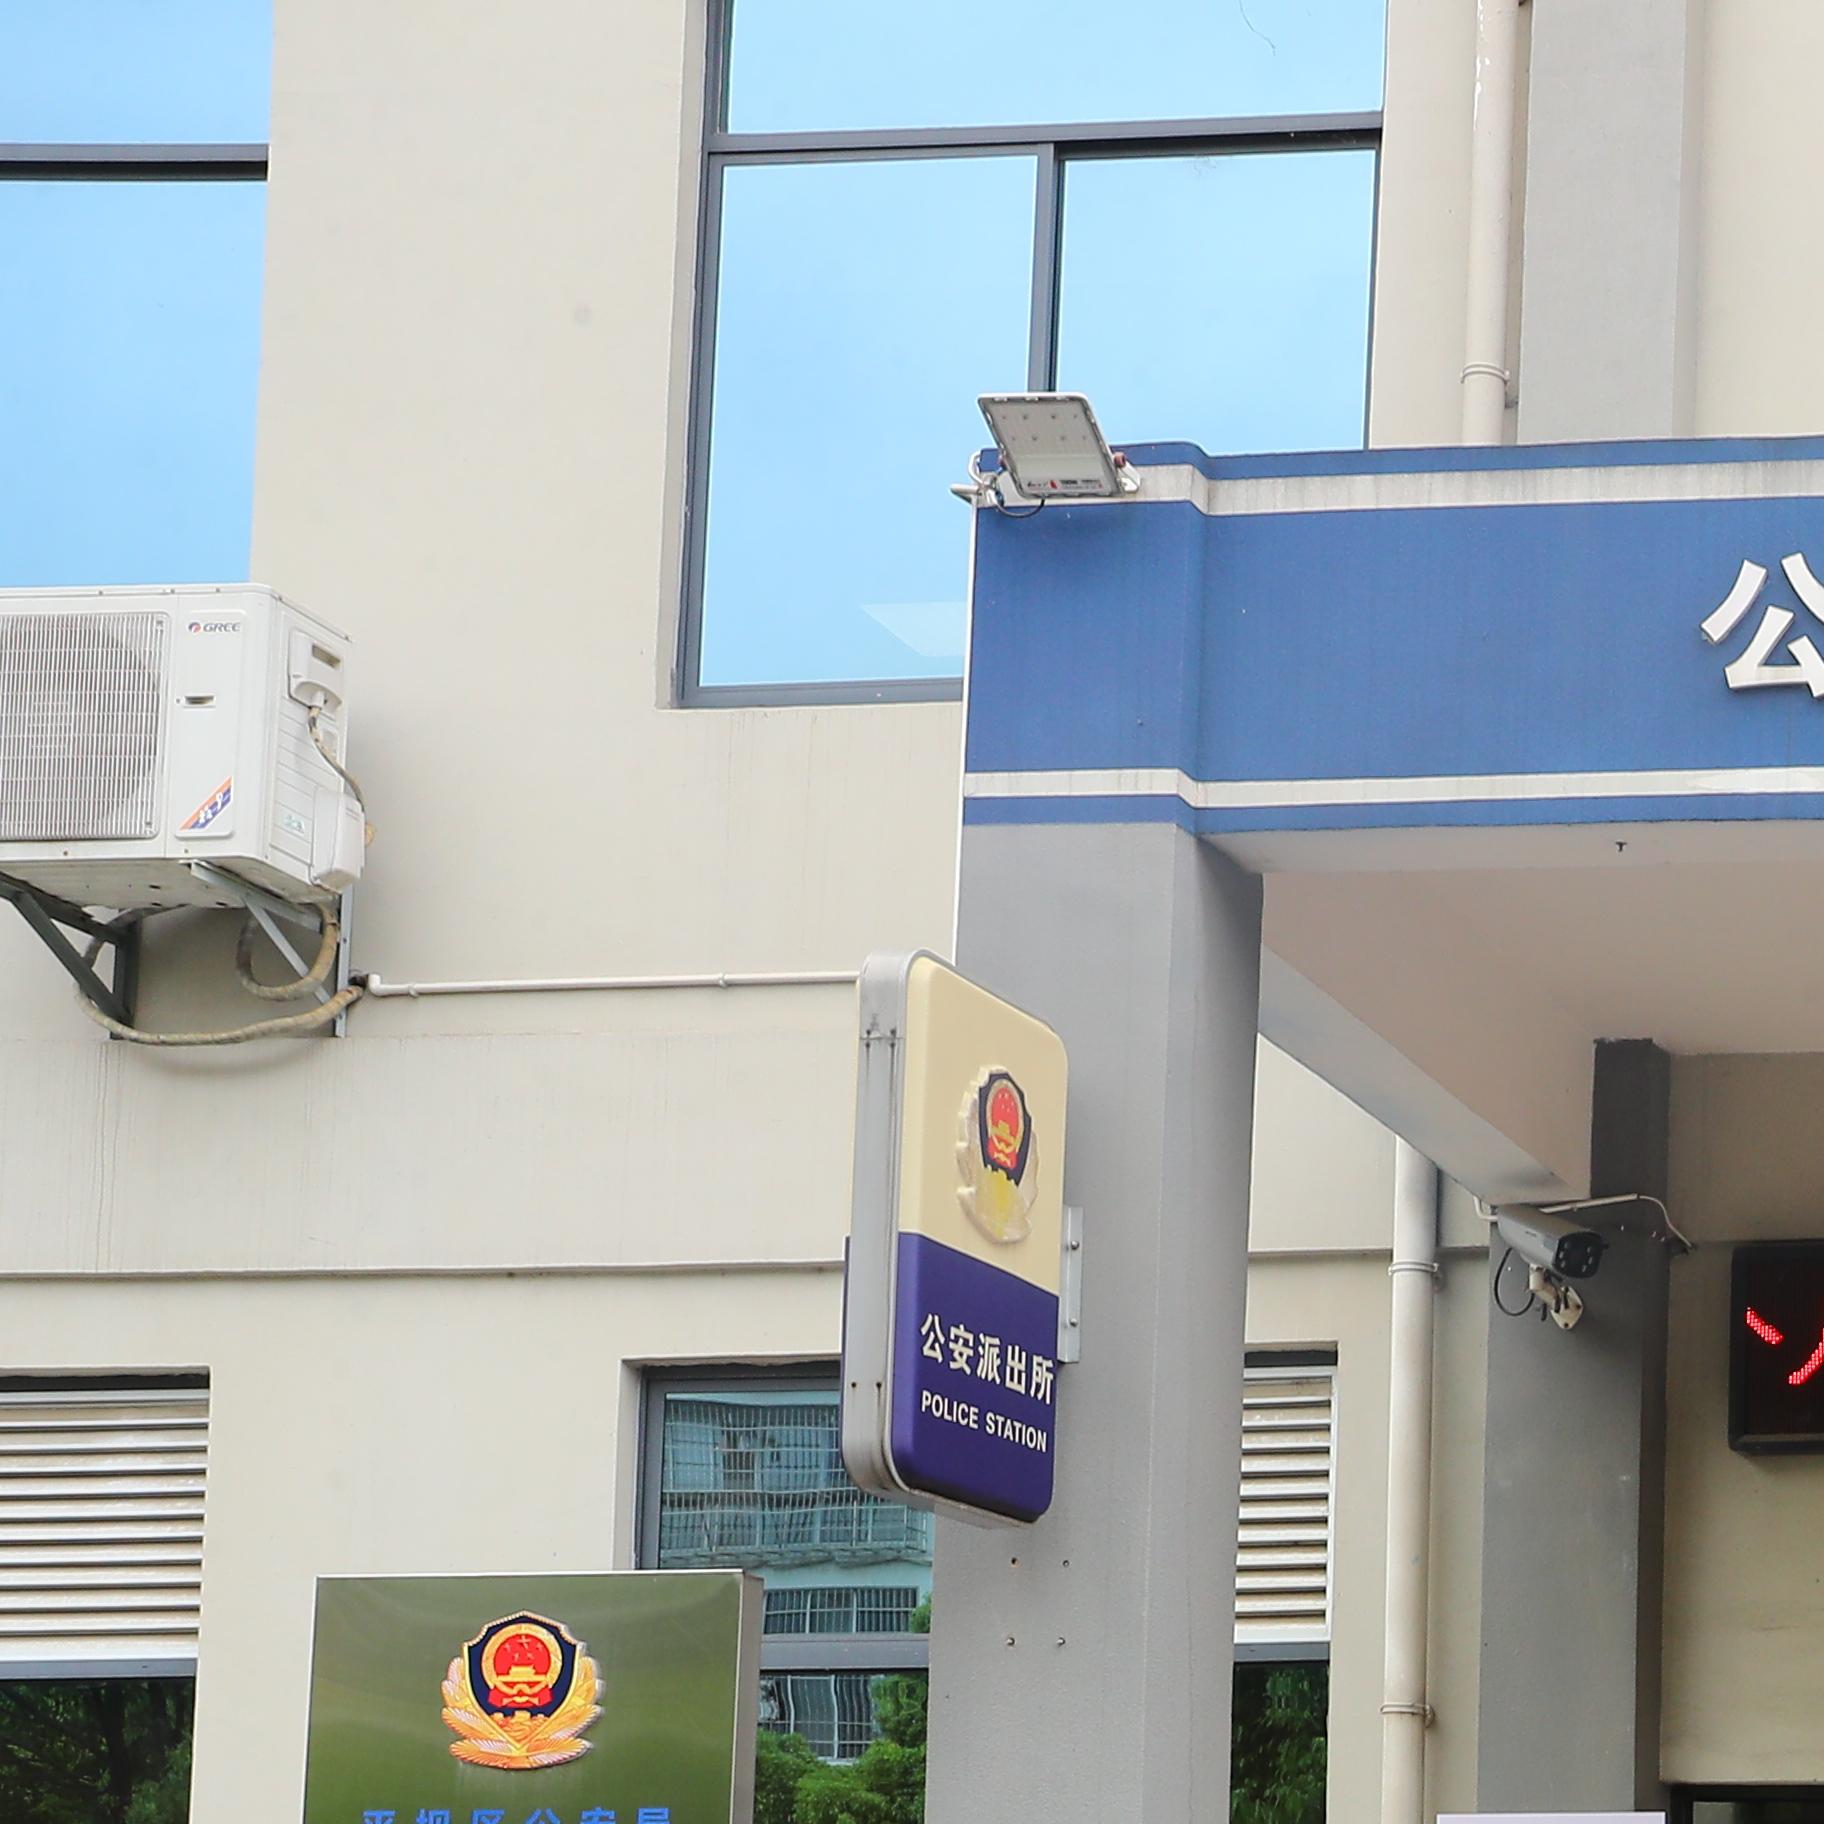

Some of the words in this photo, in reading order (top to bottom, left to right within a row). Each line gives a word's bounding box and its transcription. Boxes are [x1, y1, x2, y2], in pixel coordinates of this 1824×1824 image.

[920, 1312, 1054, 1406] 公安派出所
[921, 1390, 980, 1430] POLICE
[985, 1411, 1047, 1453] STATION
